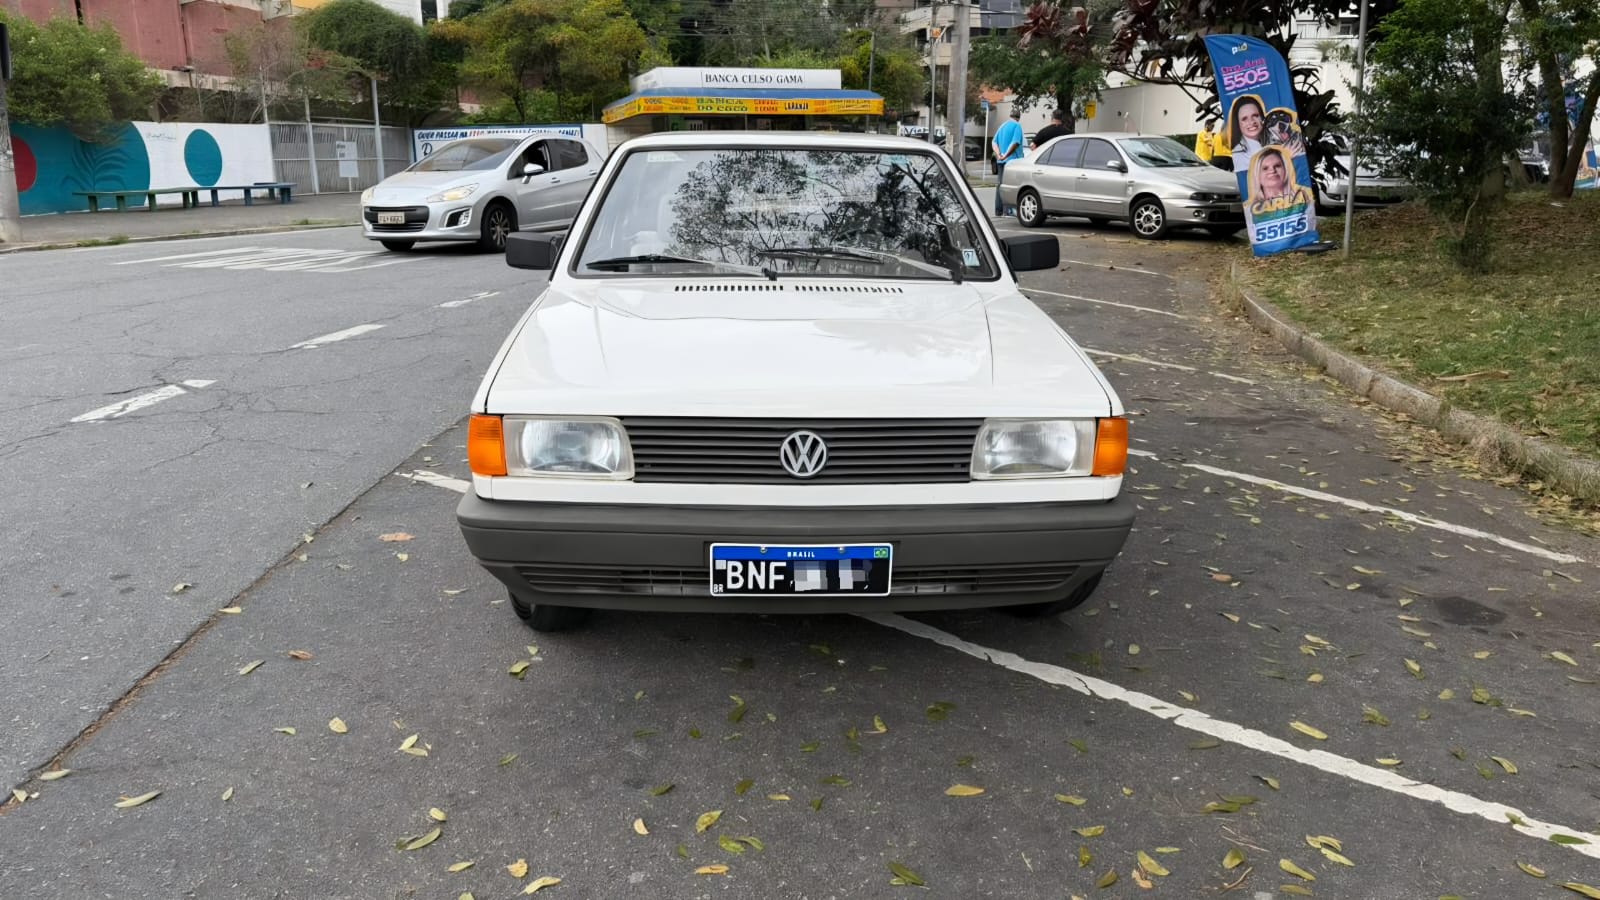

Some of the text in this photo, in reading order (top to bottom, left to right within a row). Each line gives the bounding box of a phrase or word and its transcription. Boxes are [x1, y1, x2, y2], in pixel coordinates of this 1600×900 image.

[705, 73, 804, 84] BANCA CELSO GAMA
[1223, 66, 1270, 91] 5505
[1255, 216, 1308, 242] 55155
[713, 584, 724, 593] BR
